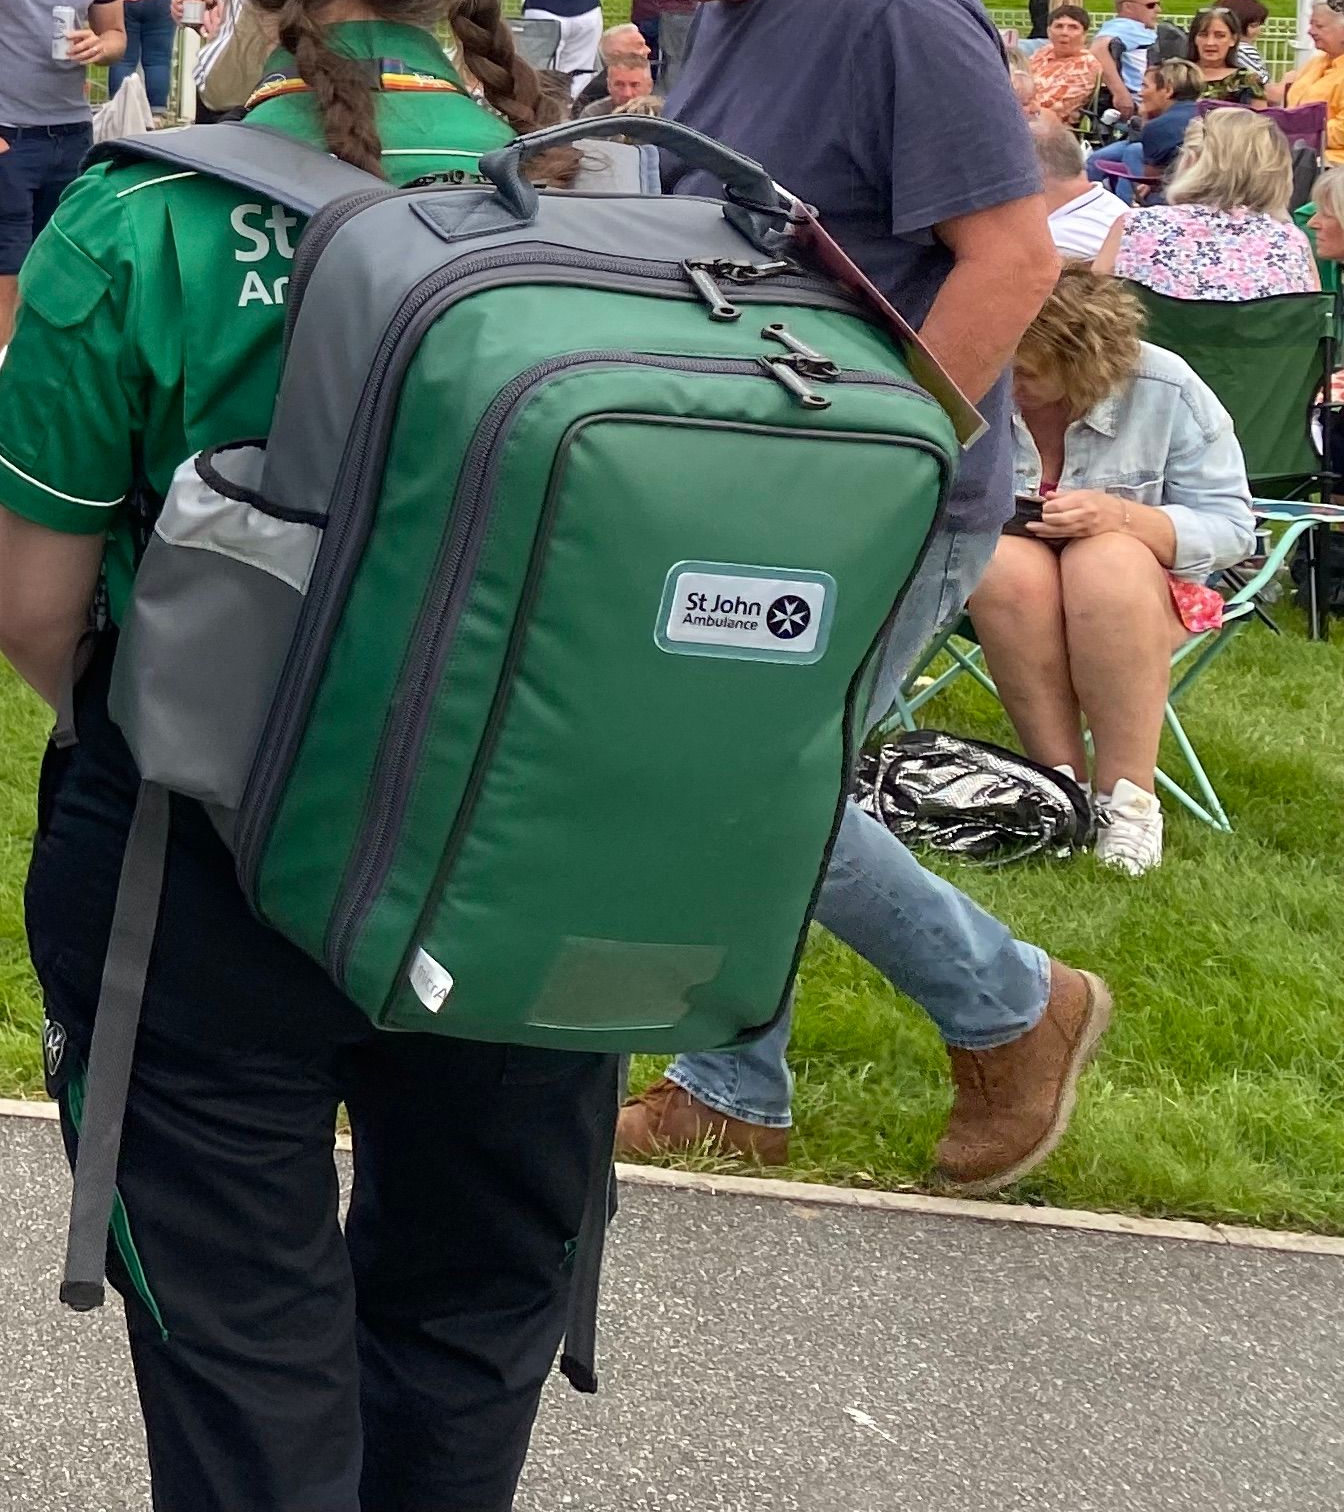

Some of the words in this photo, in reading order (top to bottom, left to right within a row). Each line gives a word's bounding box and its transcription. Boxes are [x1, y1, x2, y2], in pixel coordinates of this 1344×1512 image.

[230, 203, 297, 263] St
[685, 592, 708, 613] St
[710, 594, 762, 617] John
[682, 612, 759, 631] Ambulance
